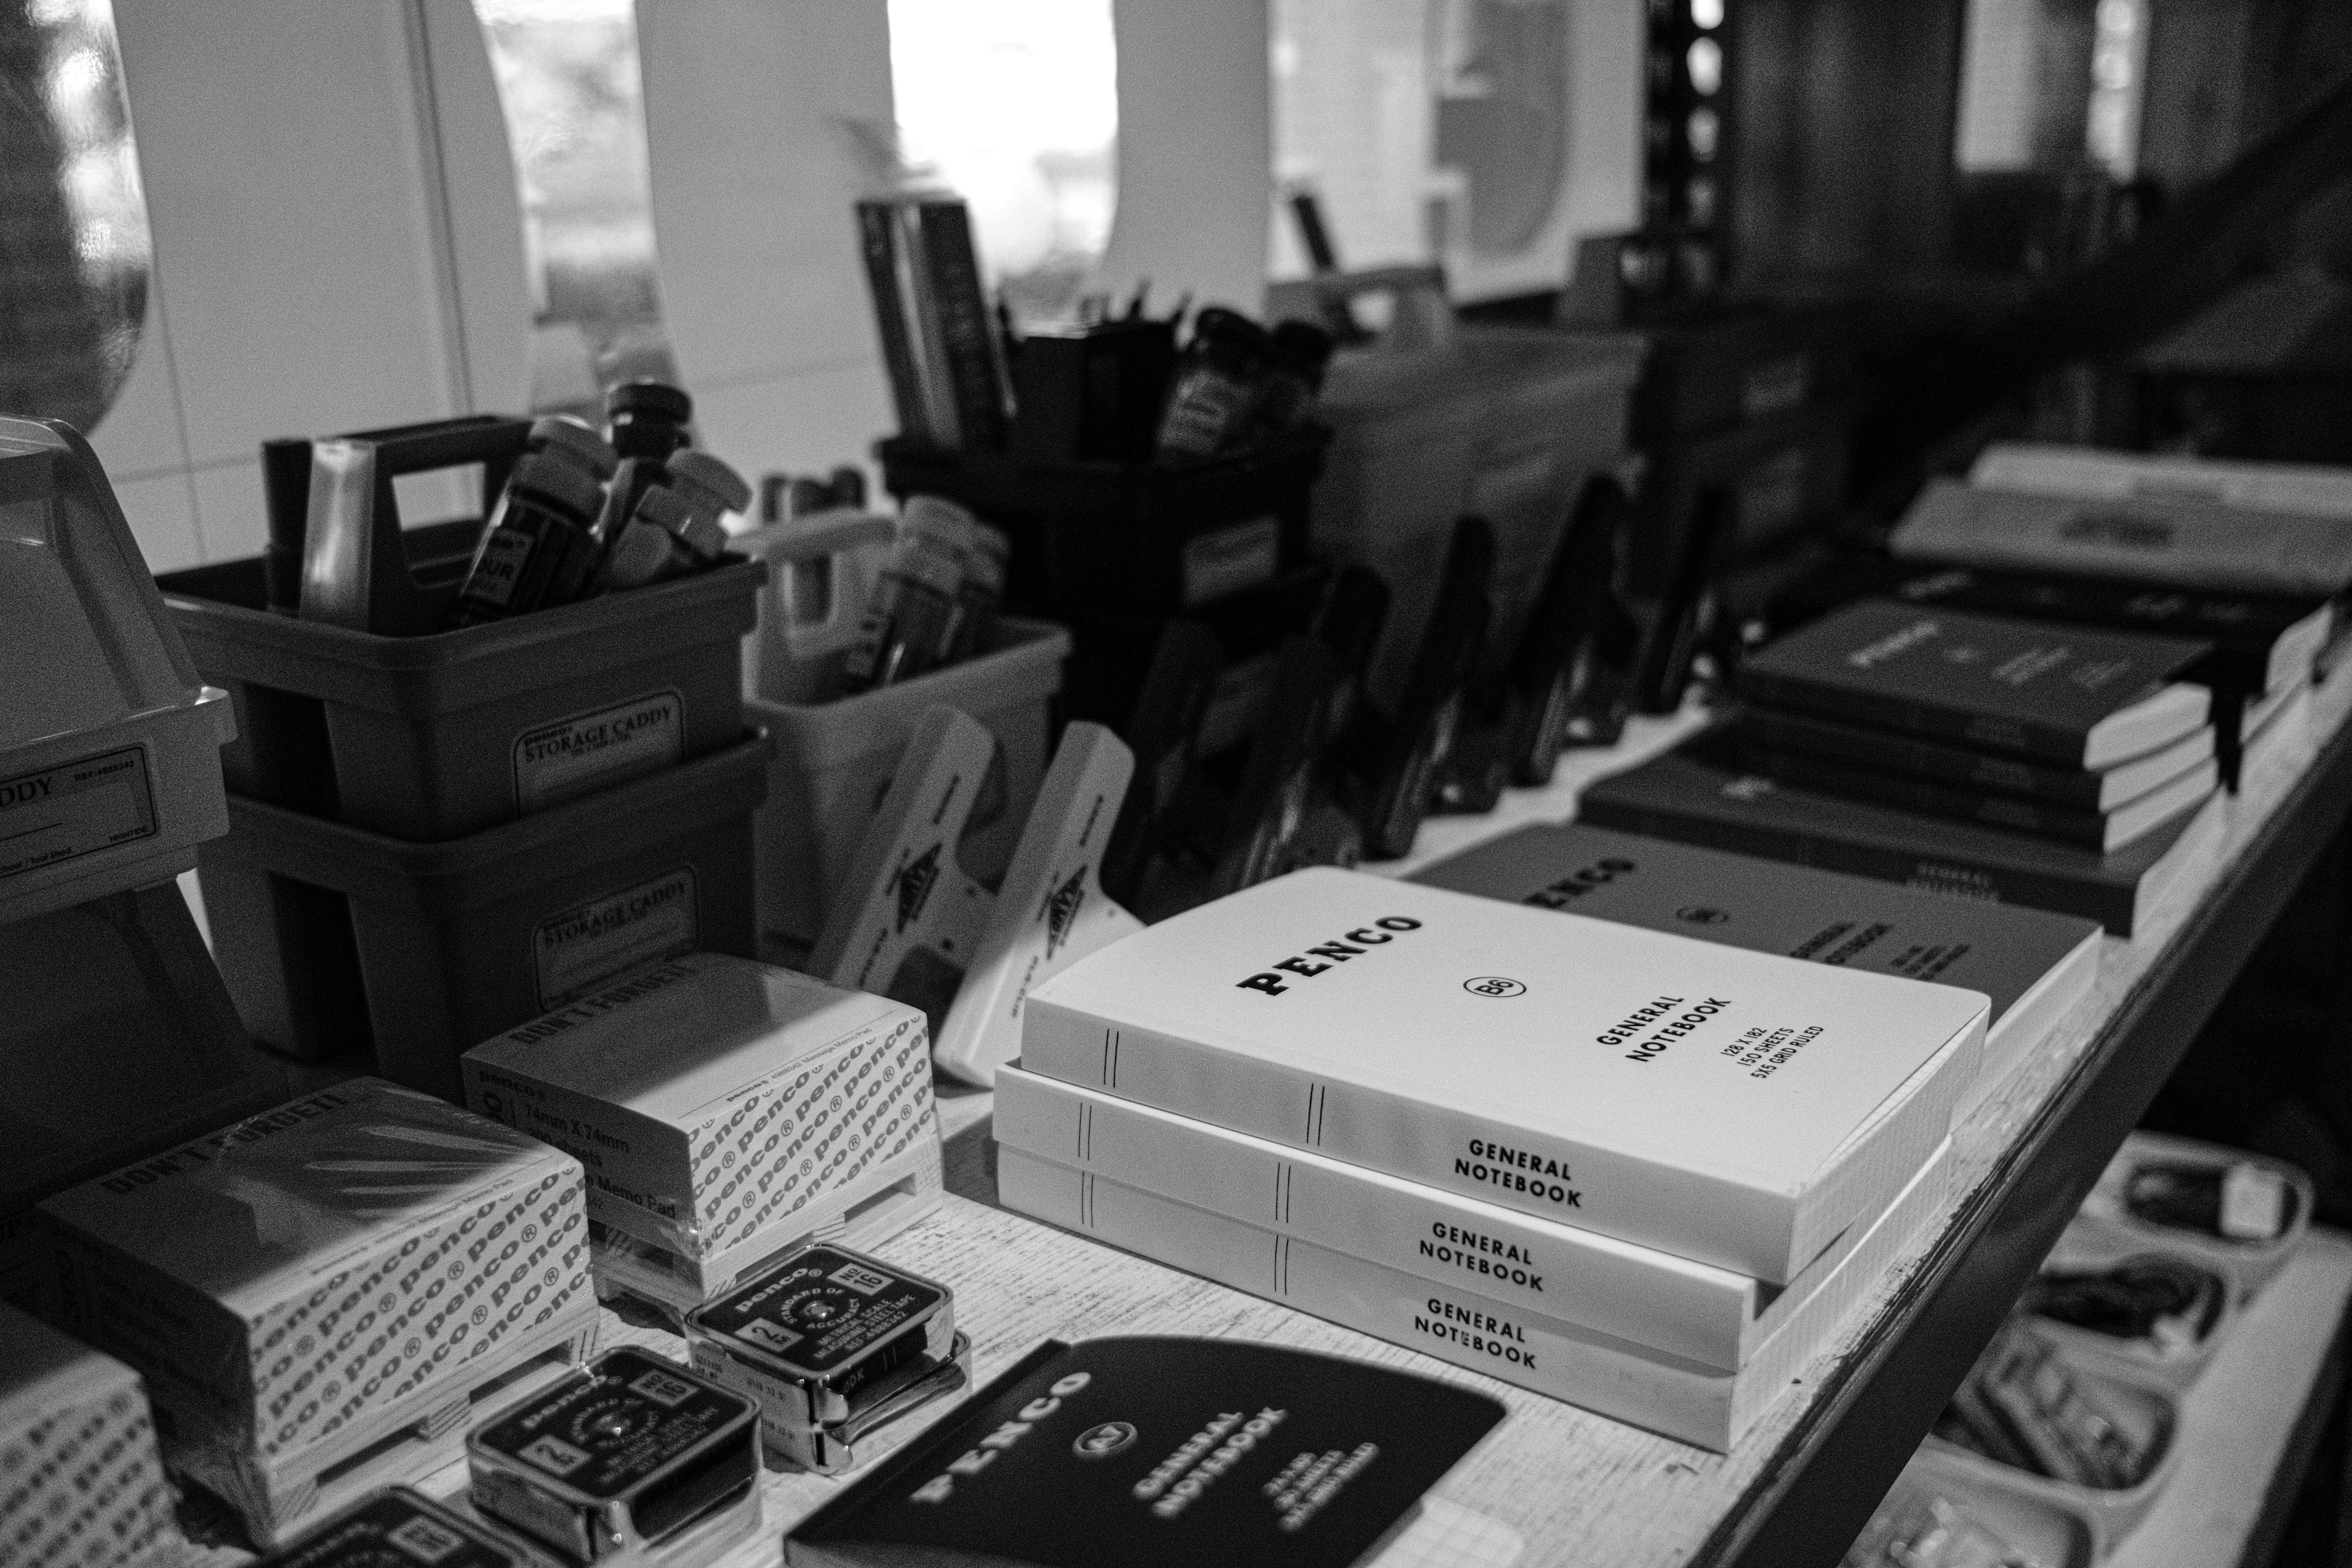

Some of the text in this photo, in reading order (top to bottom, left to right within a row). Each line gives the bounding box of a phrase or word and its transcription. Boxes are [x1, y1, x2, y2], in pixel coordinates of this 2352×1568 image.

[525, 724, 607, 762] STORAGE
[613, 707, 669, 735] CADDY
[0, 776, 53, 808] DDY
[1521, 858, 1636, 906] ENCO
[1235, 917, 1422, 995] PENCO
[1473, 979, 1513, 995] B6
[1596, 997, 1684, 1045] GENERAL
[1625, 997, 1732, 1062] NOTEBOOK
[1721, 1027, 1768, 1057] 128 X 182
[1736, 1027, 1795, 1066] 150 SHEETS
[1750, 1026, 1824, 1079] 5X5 GRID RULED
[705, 1134, 779, 1219] penco
[796, 1043, 864, 1122] penco
[738, 1071, 810, 1153] penco
[758, 1110, 829, 1193] penco
[845, 1021, 909, 1098] penco
[815, 1080, 882, 1162] penco
[583, 1124, 629, 1153] 74mm
[779, 1148, 847, 1220] enco
[862, 1058, 926, 1136] penco
[833, 1118, 899, 1189] enco
[1470, 1139, 1571, 1181] GENERAL
[597, 1175, 643, 1205] Memo
[647, 1193, 676, 1220] Pad
[1455, 1158, 1580, 1207] NOTEBOOK
[400, 1201, 496, 1294] penco
[1419, 1240, 1543, 1291] NOTEBOOK
[1432, 1222, 1531, 1265] GENERAL
[318, 1237, 421, 1337] penco
[345, 1278, 446, 1383] penco
[468, 1173, 559, 1263] penco
[736, 1268, 808, 1312] penco
[854, 1274, 883, 1289] 16
[383, 1323, 469, 1404] enco
[492, 1213, 581, 1308] penco
[457, 1284, 542, 1366] enco
[781, 1288, 822, 1324] STANDARD
[806, 1298, 860, 1329] ACCURACY
[1427, 1298, 1525, 1343] GENERAL
[307, 1356, 402, 1444] enco
[425, 1240, 519, 1339] penco
[748, 1325, 782, 1340] 2
[1415, 1316, 1536, 1369] NOTEBOOK
[909, 1372, 1092, 1503] PENCO
